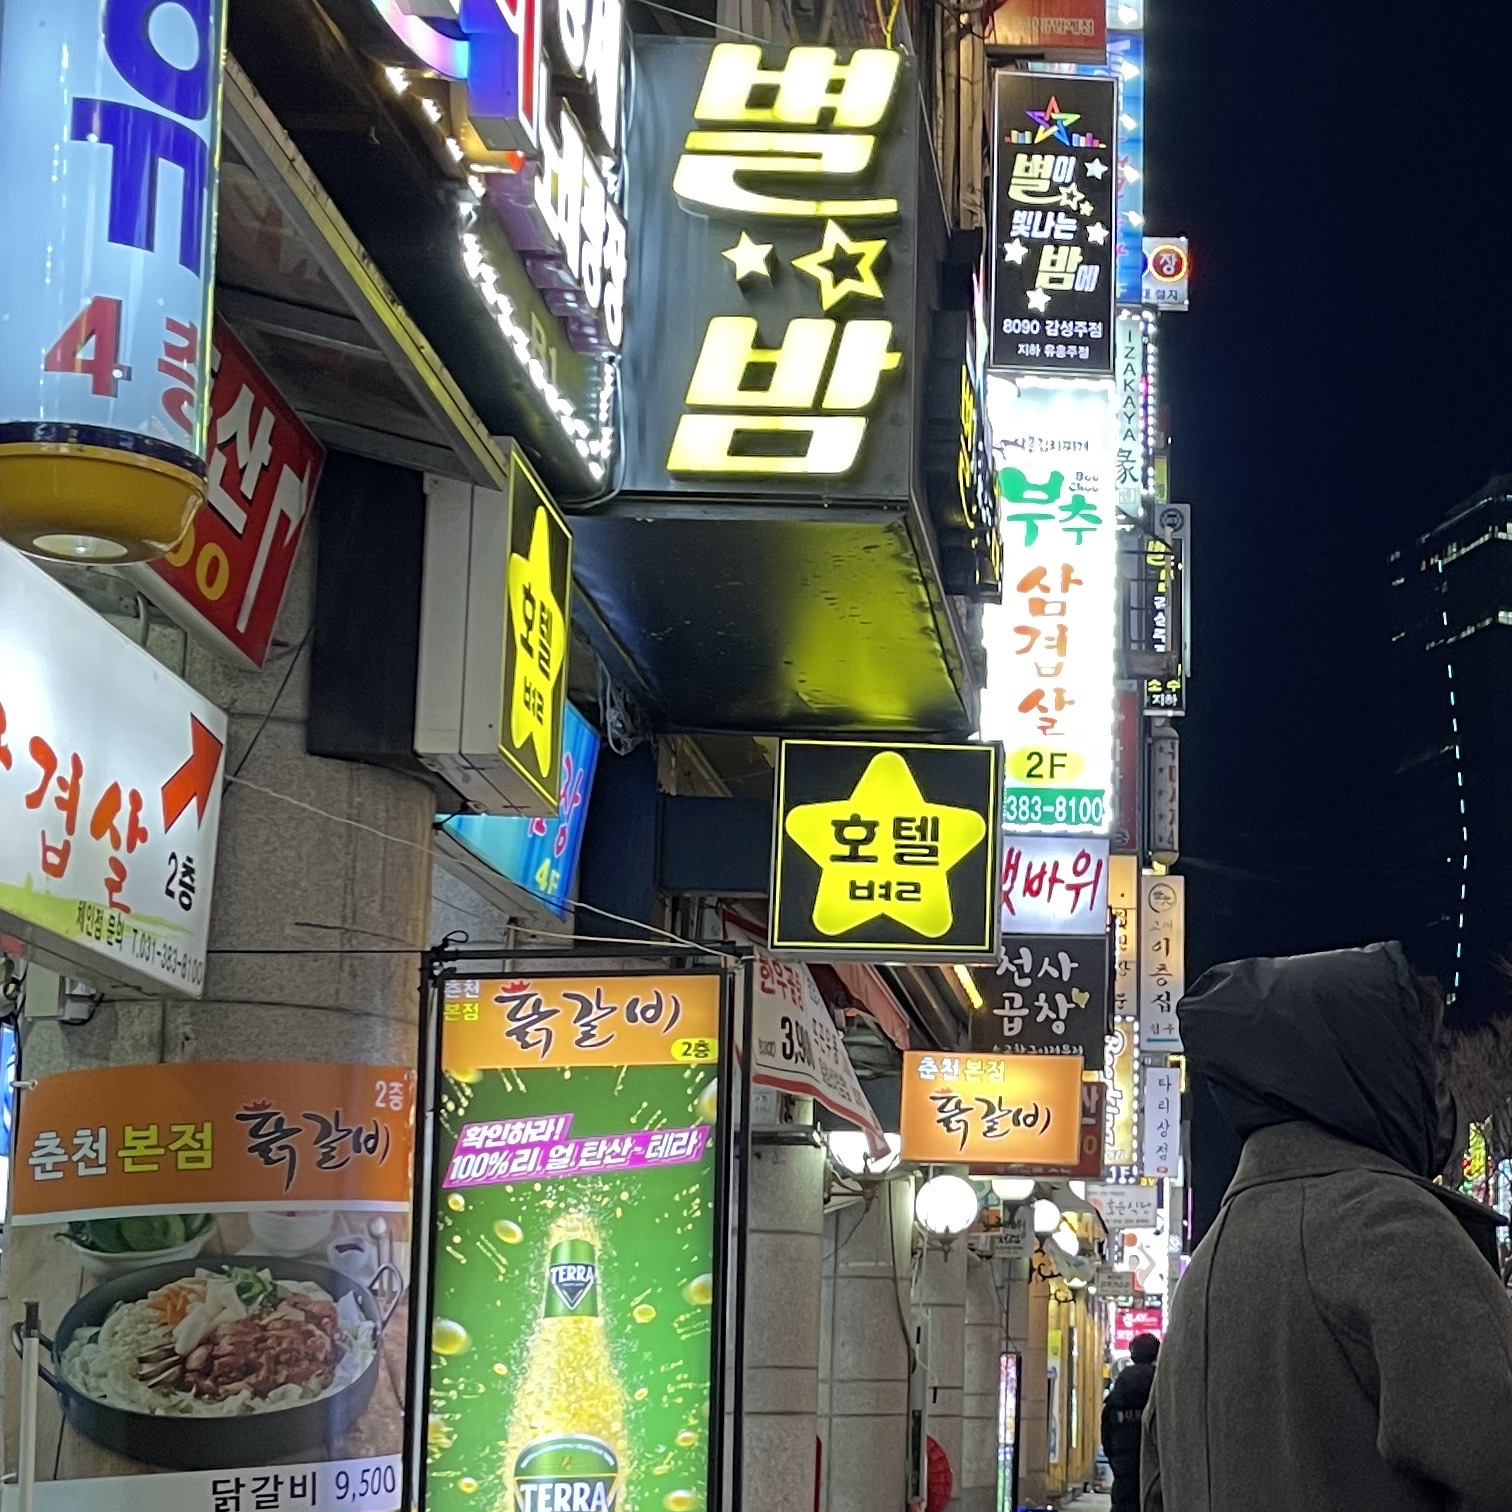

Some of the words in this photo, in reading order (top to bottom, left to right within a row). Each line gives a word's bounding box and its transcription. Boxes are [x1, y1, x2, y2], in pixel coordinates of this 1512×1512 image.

[671, 42, 900, 216] 별
[1007, 152, 1077, 205] 별이
[1009, 209, 1079, 241] 빛나는
[1034, 244, 1101, 293] 밤에
[1002, 318, 1041, 335] 8090
[1045, 318, 1104, 339] 감성주점
[1017, 343, 1041, 358] 지하
[666, 315, 902, 475] 밤
[1122, 329, 1137, 443] IZAKAYA
[998, 465, 1103, 548] 부추
[520, 582, 554, 682] 호텔
[1012, 562, 1084, 736] 삼겹살
[1025, 750, 1068, 780] 2F
[0, 703, 151, 914] 겹살
[1005, 794, 1103, 824] 383-8100
[828, 813, 941, 867] 호텔
[164, 849, 197, 912] 2층
[995, 945, 1080, 989] 천사
[443, 1003, 480, 1022] 본점
[992, 991, 1077, 1037] 곱창
[681, 1040, 711, 1060] 2층
[916, 1057, 961, 1081] 춘천
[965, 1058, 1006, 1084] 본점
[28, 1127, 108, 1183] 춘천
[117, 1121, 214, 1174] 본점
[464, 1114, 564, 1149] 확인하라!
[551, 1265, 595, 1284] TERRA
[210, 1472, 319, 1512] 닭갈비
[334, 1465, 397, 1503] 9,500
